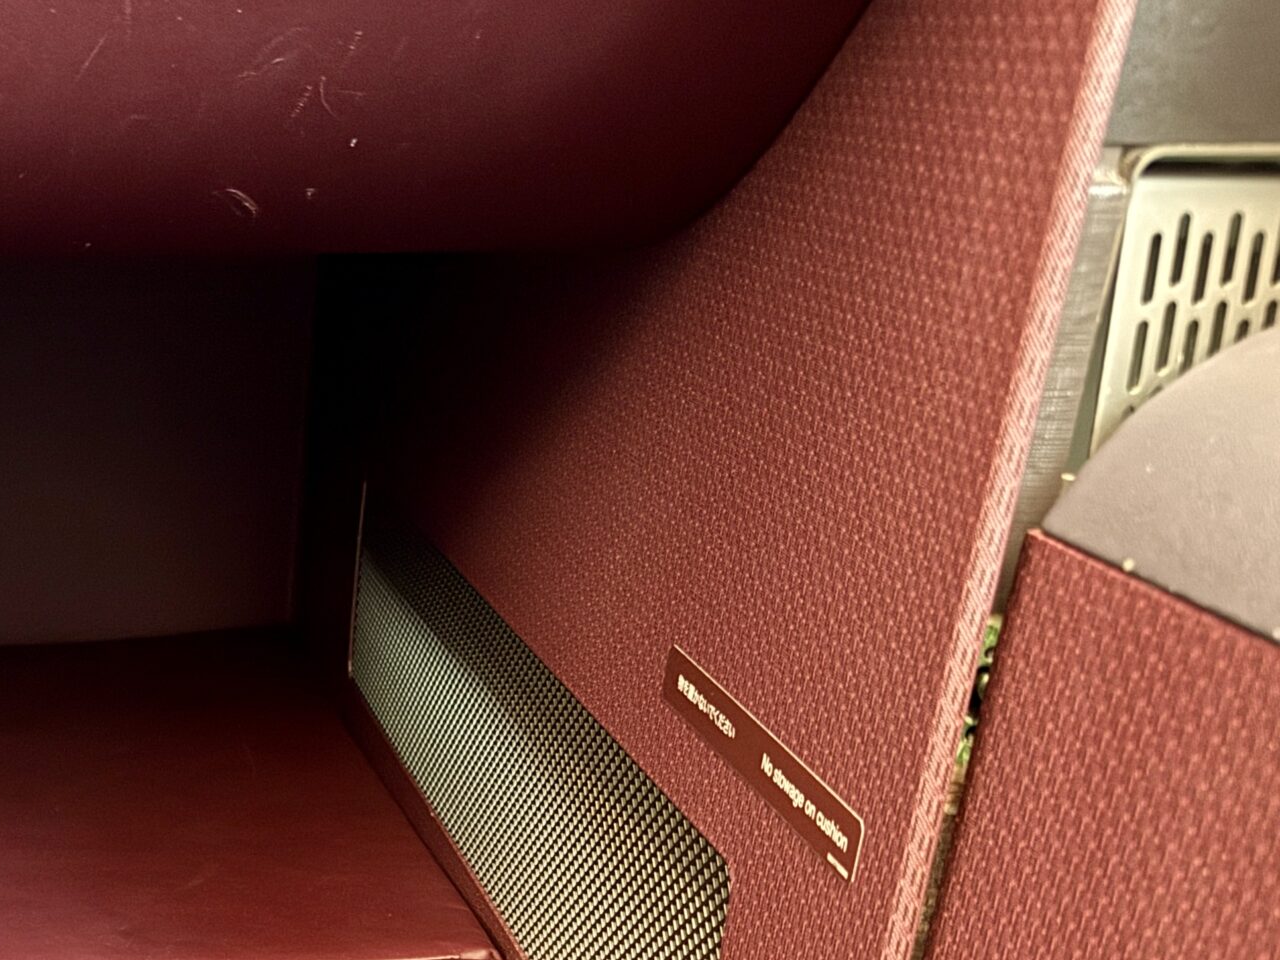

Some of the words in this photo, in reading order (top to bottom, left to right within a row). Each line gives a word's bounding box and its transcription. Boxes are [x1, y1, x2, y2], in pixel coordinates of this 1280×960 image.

[761, 752, 773, 777] No
[772, 768, 805, 808] stowage
[804, 800, 817, 820] on
[816, 811, 848, 853] cushion
